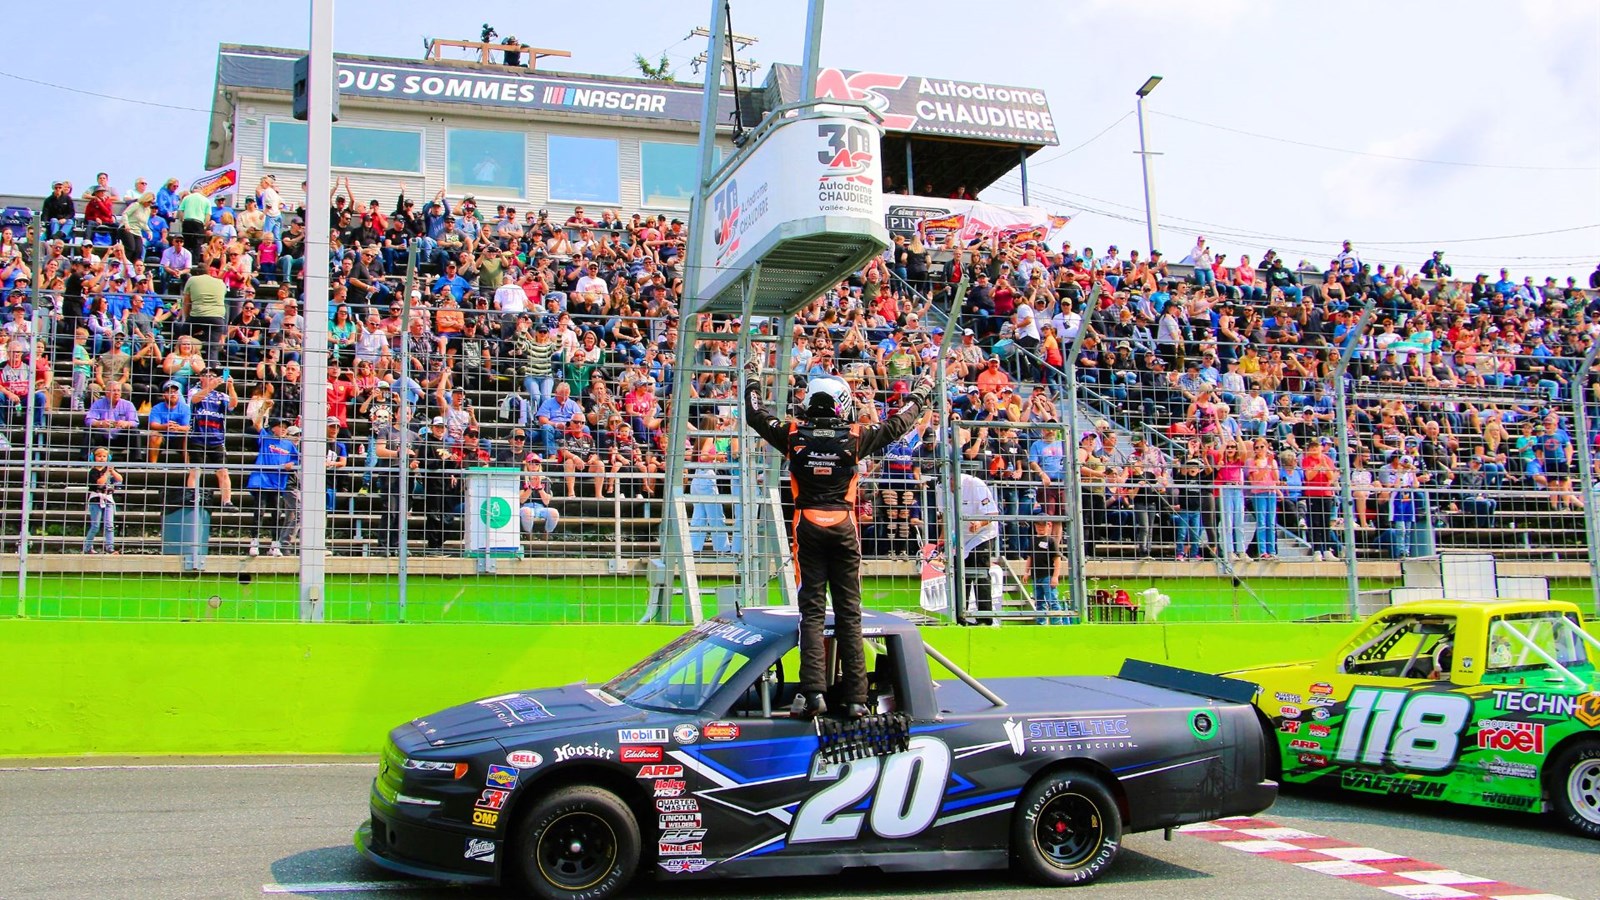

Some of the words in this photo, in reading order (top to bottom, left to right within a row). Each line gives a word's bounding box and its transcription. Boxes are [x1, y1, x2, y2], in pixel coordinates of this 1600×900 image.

[338, 69, 396, 92] OUS
[402, 75, 535, 103] SOMMES
[573, 88, 667, 113] NASCAR
[918, 77, 1047, 106] Autodrome
[915, 100, 1055, 131] CHAUDIERE
[818, 124, 870, 165] 30
[818, 181, 872, 194] Autodrome
[818, 191, 872, 206] CHAUDIERE
[890, 217, 915, 229] PIN
[1029, 719, 1130, 738] STEELTEC
[1336, 689, 1472, 771] 118
[1478, 719, 1516, 729] GROUPE
[621, 730, 653, 740] Mobil
[655, 729, 666, 740] 1
[1478, 723, 1544, 754] noël
[1032, 741, 1133, 753] CONSTRUCTION
[1291, 740, 1319, 749] ARP
[511, 754, 537, 763] BELL
[553, 742, 615, 763] Hoosier
[623, 749, 659, 759] Edelbrock
[639, 765, 682, 776] ARP
[489, 772, 516, 783] SUNOCO
[655, 779, 686, 790] Holley
[788, 735, 951, 844] 20
[654, 789, 681, 797] MSD
[658, 799, 695, 808] QUARTER
[1025, 780, 1072, 824] Hoosier
[472, 811, 498, 826] OMP
[661, 814, 694, 822] LINCOLN
[660, 843, 702, 852] WHELEN
[1073, 836, 1118, 881] Hoosier
